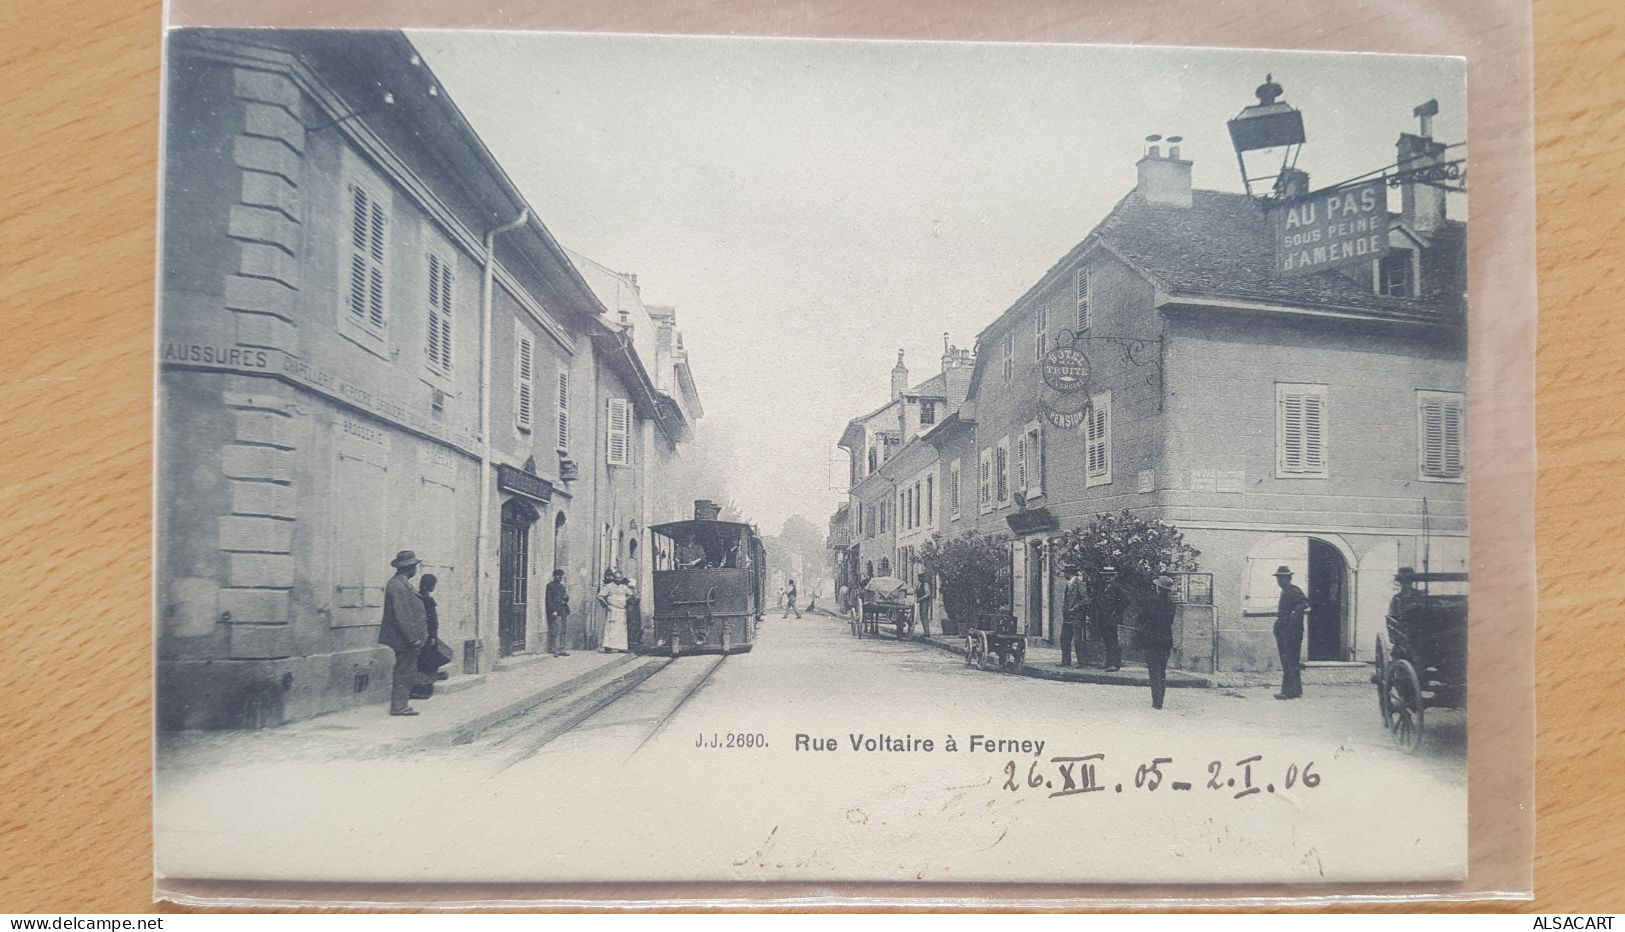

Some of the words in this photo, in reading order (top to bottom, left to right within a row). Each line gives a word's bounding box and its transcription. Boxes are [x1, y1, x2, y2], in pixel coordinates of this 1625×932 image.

[1285, 202, 1316, 230] AU
[1327, 188, 1376, 220] PAS
[1284, 229, 1321, 248] SOUS
[1328, 216, 1379, 238] PEINE
[1284, 235, 1381, 271] d'AMENDE
[1046, 365, 1088, 376] TRUITE
[1050, 410, 1083, 427] PENSION
[695, 732, 770, 749] J.J.2690.
[795, 733, 838, 751] Rue
[849, 733, 934, 751] Voltaire
[945, 734, 958, 752] à
[969, 735, 1045, 757] Ferney
